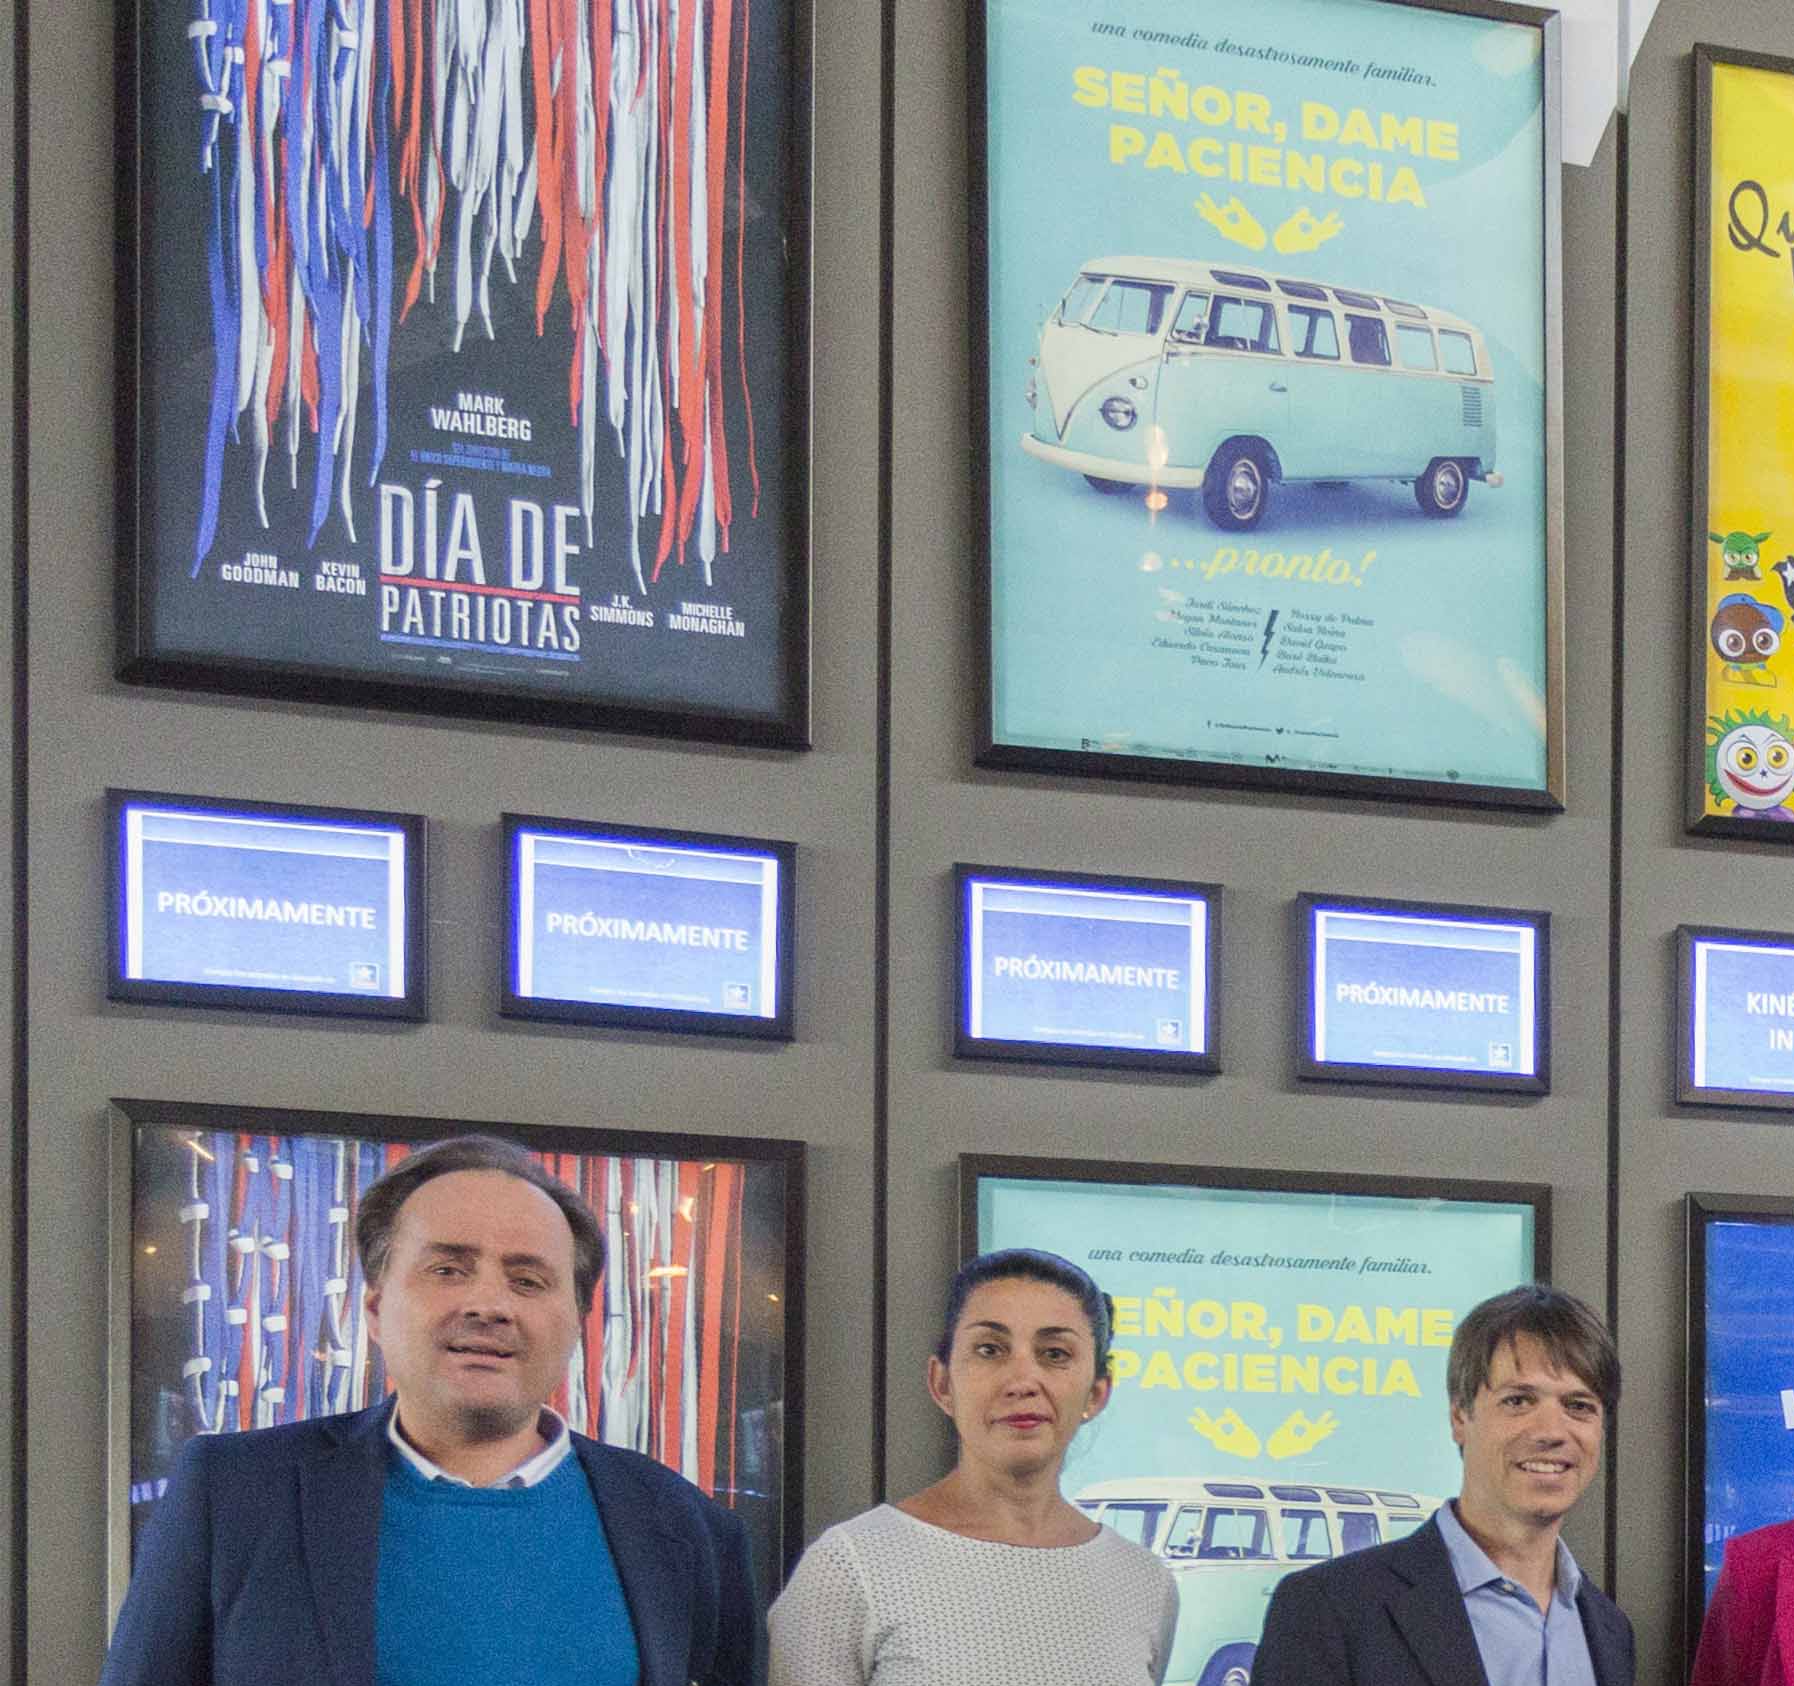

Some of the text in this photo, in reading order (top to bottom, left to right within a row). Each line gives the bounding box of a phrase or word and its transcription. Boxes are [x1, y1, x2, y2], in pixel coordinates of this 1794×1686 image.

[1091, 20, 1125, 38] una
[1133, 28, 1207, 51] comedia
[1214, 37, 1361, 75] desastrosamente
[1301, 101, 1461, 161] DAME
[1109, 124, 1427, 209] PACIENCIA
[457, 393, 504, 415] MARK
[431, 408, 532, 441] WAHLBERG
[380, 479, 581, 597] DÍA DE
[222, 564, 299, 588] GOODMAN
[244, 552, 277, 568] JOHN
[321, 561, 360, 578] KEVIN
[315, 574, 366, 596] BACON
[380, 585, 581, 652] PATRIOTAS
[590, 605, 654, 628] SIMMONS
[669, 614, 745, 637] MONAGHAN
[681, 602, 733, 620] MICHELLE
[157, 887, 377, 930] PRÓXIMAMENTE
[547, 910, 749, 952] PRÓXIMAMENTE
[994, 952, 1180, 991] PRÓXIMAMENTE
[1336, 980, 1510, 1015] PRÓXIMAMENTE
[1088, 1248, 1122, 1262] una
[1129, 1247, 1204, 1265] comedia
[1210, 1250, 1356, 1273] desastrosamente
[1112, 1287, 1455, 1349] EÑOR, DAME
[1107, 1349, 1423, 1398] PACIENCIA
